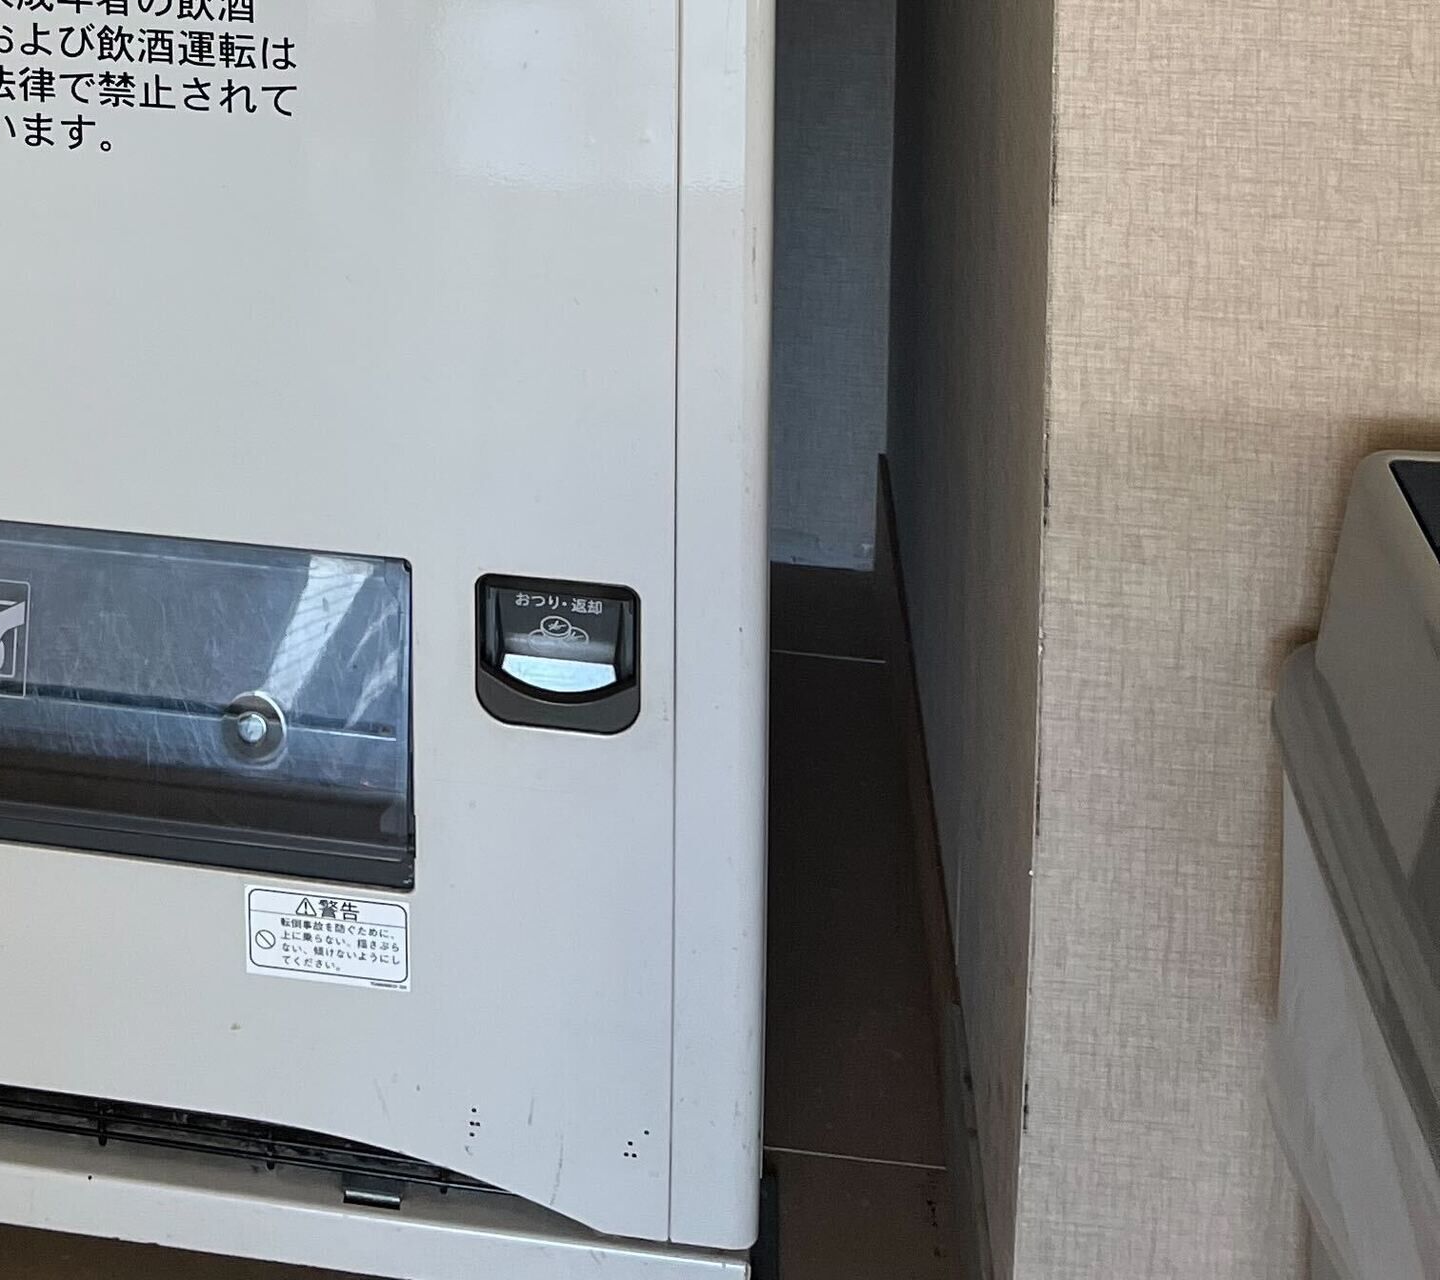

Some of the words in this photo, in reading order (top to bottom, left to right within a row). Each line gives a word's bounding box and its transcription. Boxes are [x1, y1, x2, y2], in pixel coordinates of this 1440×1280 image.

[515, 592, 603, 615] おつり・返却
[318, 899, 360, 922] 警告
[280, 917, 396, 939] 転倒事故を防ぐために、
[281, 942, 400, 965] ない、傾けないようにし
[282, 955, 342, 972] てください。
